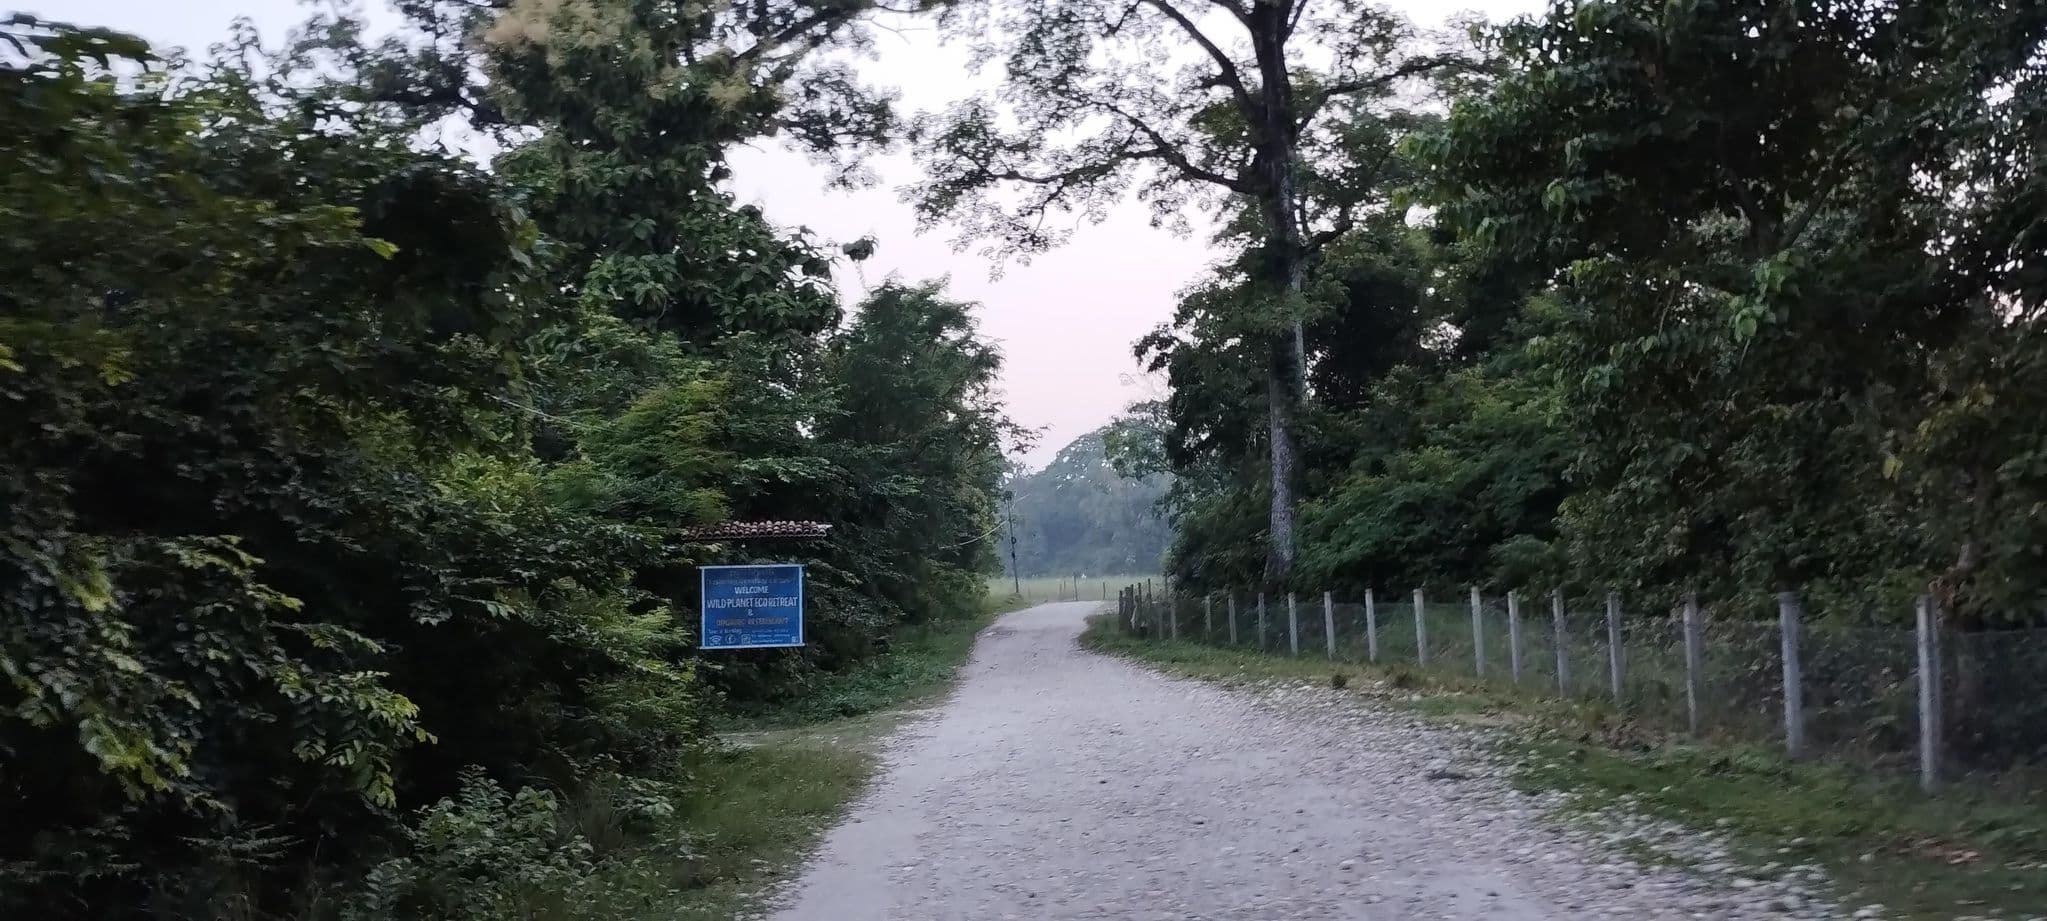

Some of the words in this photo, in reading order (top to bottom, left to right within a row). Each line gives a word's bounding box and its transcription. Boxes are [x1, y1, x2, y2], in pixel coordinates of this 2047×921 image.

[734, 586, 769, 594] WELCOME
[707, 599, 727, 608] WILD
[727, 598, 753, 608] PLANET
[755, 598, 768, 607] ECO
[769, 597, 798, 607] RETREAT
